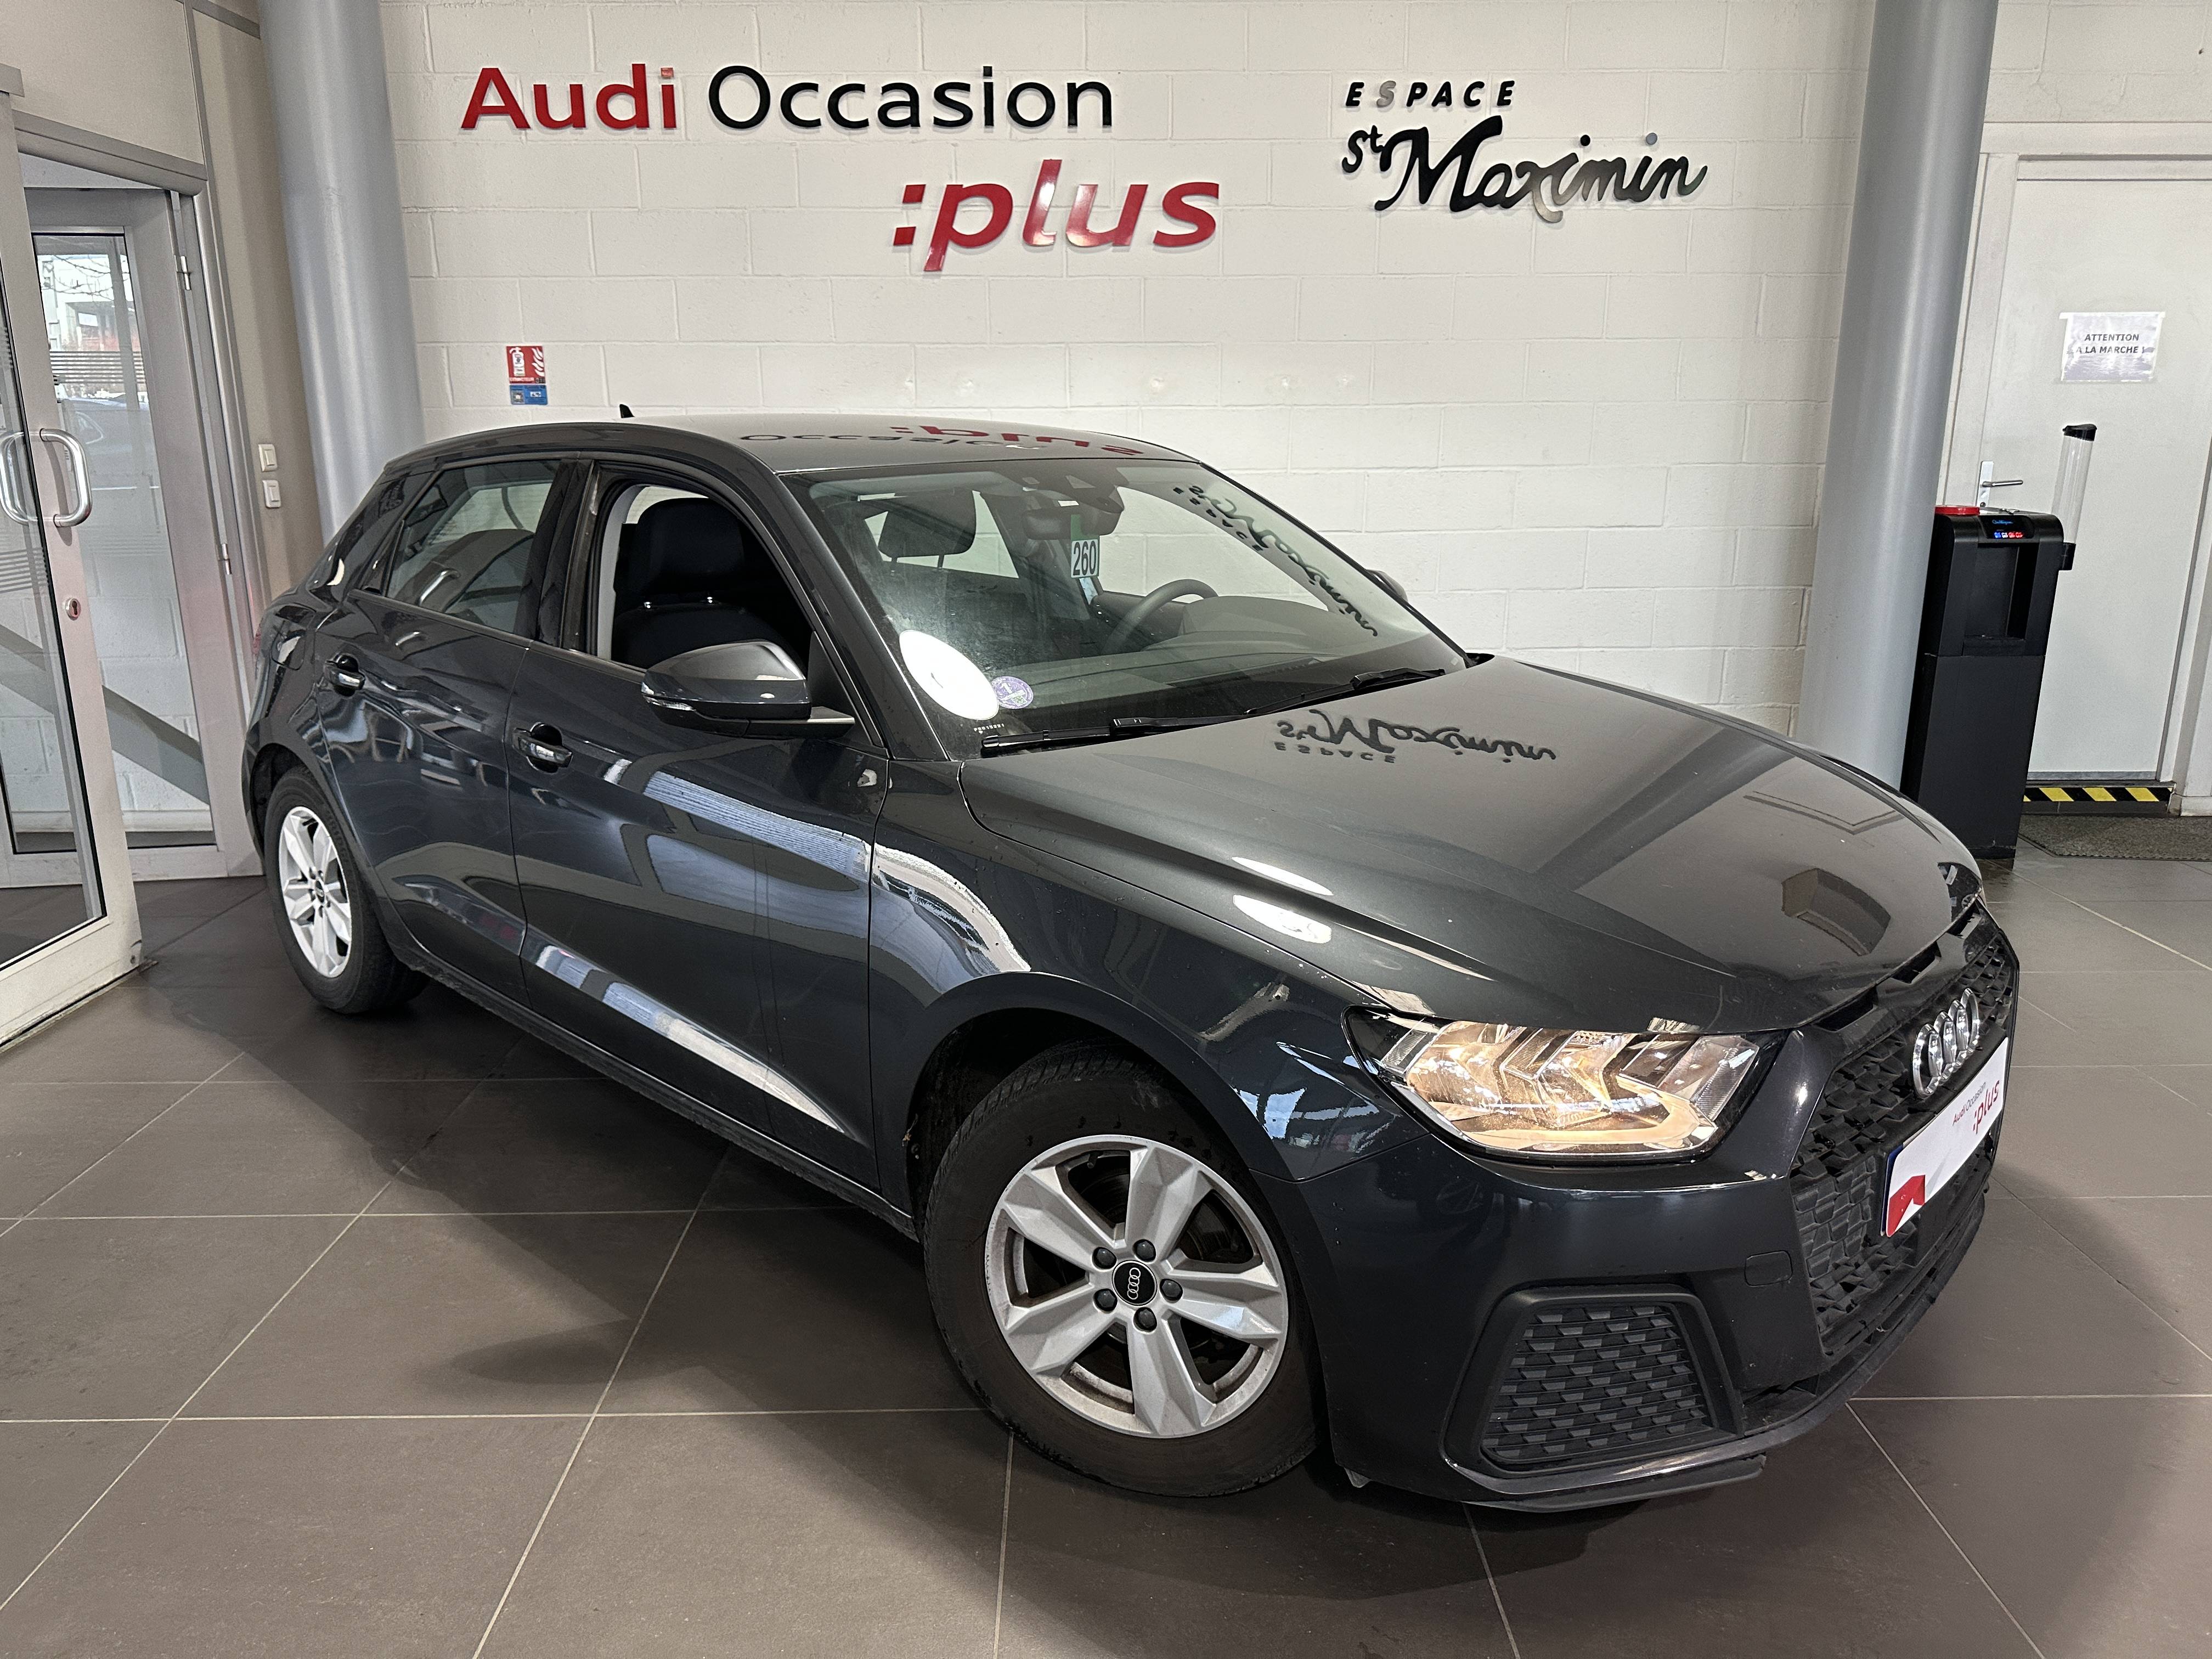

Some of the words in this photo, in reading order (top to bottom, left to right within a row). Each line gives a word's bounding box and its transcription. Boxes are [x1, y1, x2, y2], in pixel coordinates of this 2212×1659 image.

[460, 63, 678, 131] Audi
[708, 65, 1113, 131] Occasion
[1345, 80, 1515, 108] ESPACE
[1374, 115, 1708, 223] Maximin
[1073, 540, 1097, 576] 260
[1953, 1103, 1966, 1127] Audi
